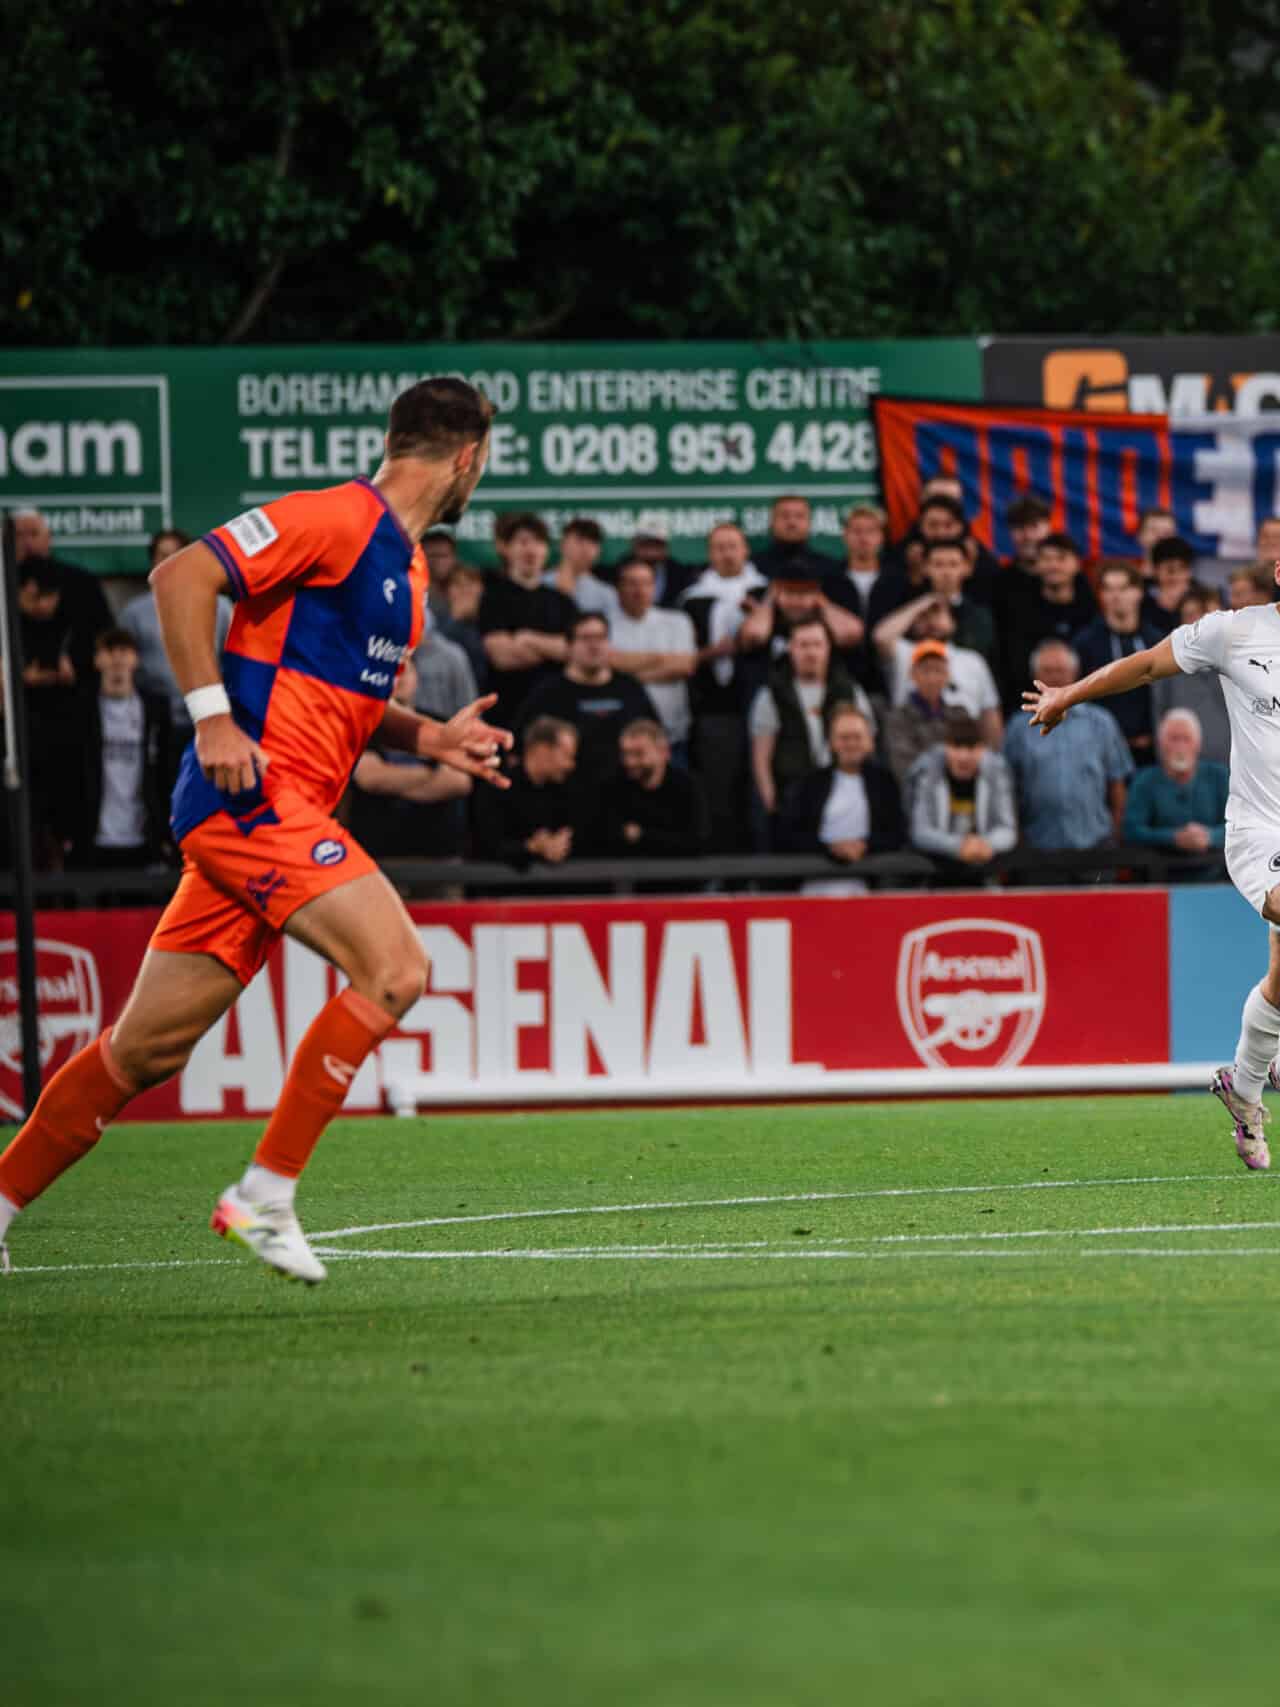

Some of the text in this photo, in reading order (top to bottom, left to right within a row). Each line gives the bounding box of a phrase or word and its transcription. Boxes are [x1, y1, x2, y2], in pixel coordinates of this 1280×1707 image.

[529, 368, 739, 412] ENTERPRISE
[746, 366, 882, 410] CENTRE
[240, 419, 876, 478] TELEPE: 0208 953 4428
